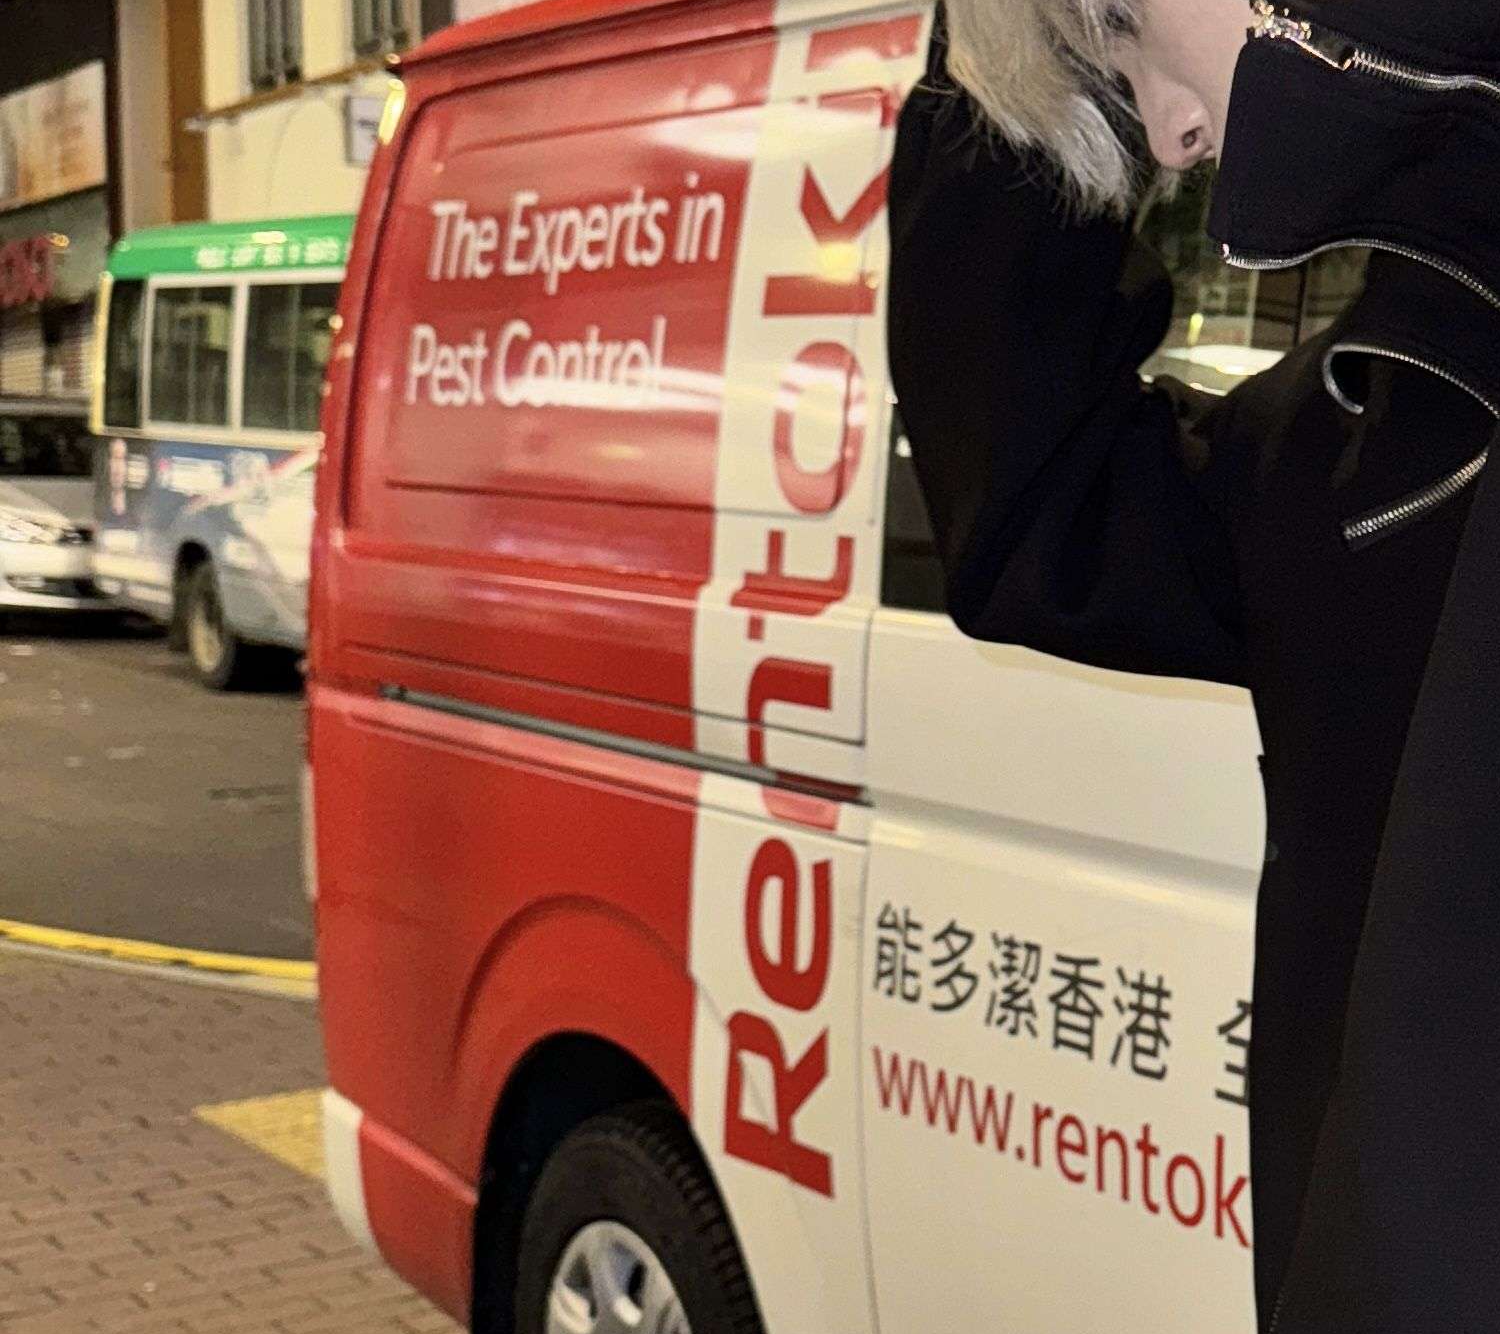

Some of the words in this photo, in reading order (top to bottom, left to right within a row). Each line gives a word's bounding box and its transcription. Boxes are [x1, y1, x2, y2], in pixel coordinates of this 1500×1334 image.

[427, 200, 499, 282] The
[502, 188, 667, 296] Experts
[671, 170, 726, 264] in
[404, 322, 488, 407] Pest
[493, 315, 667, 407] Control
[873, 901, 1173, 1082] 能多潔香港
